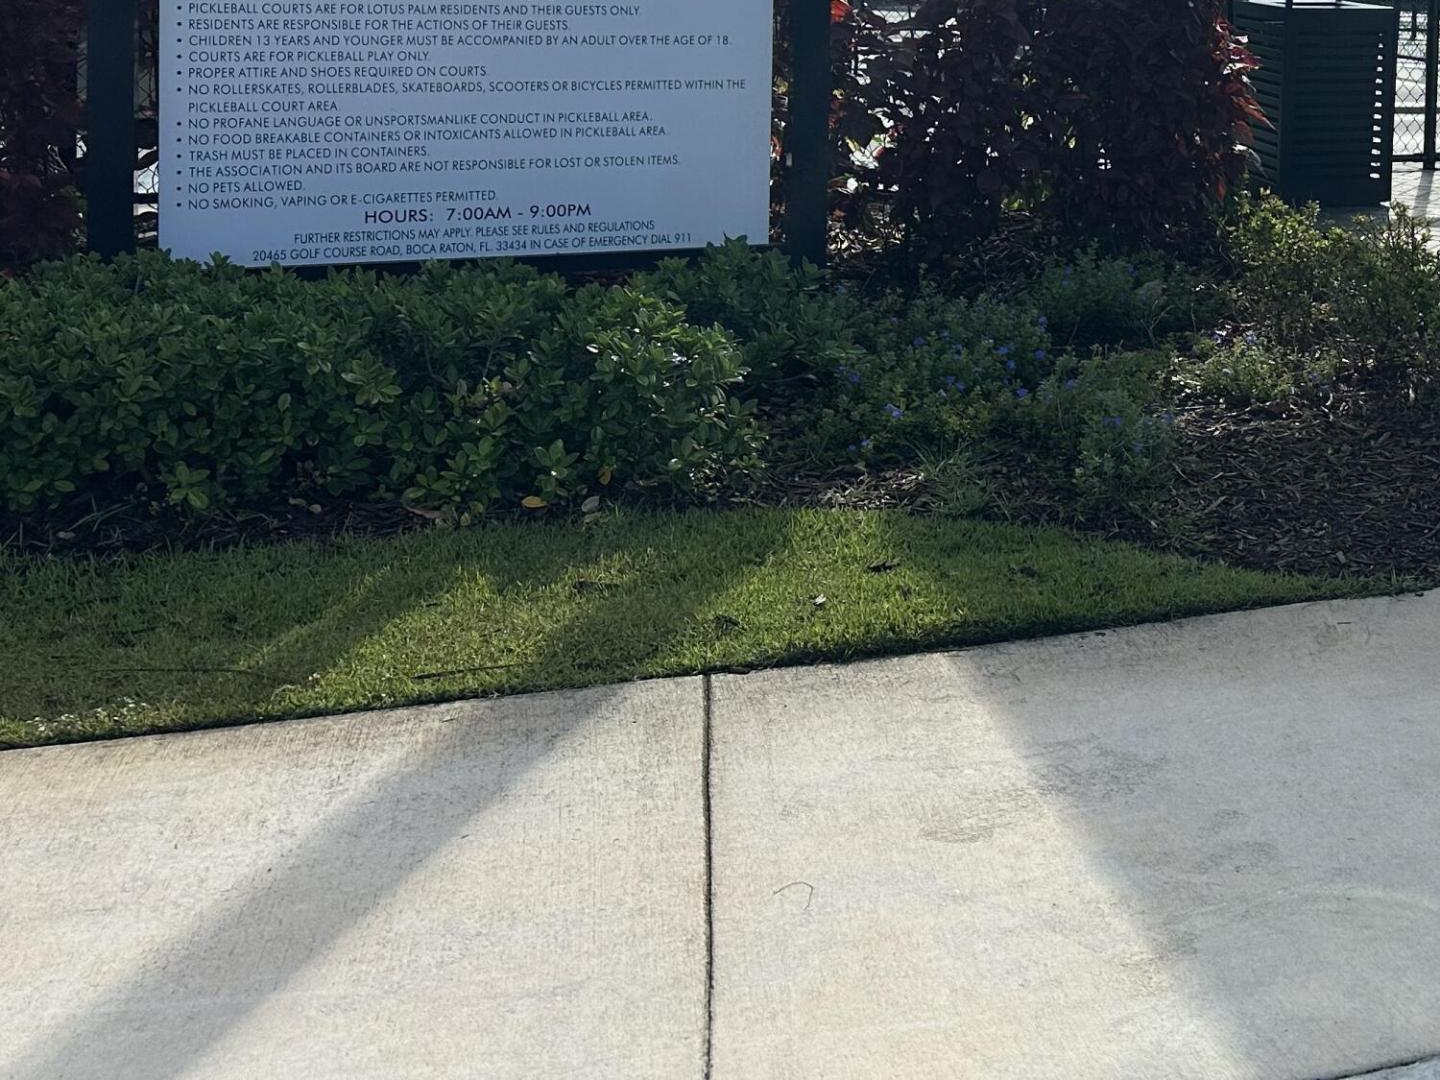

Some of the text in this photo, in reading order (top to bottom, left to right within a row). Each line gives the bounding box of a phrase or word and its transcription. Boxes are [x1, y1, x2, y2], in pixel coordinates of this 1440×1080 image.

[188, 2, 258, 14] PICKLEBALL
[260, 2, 312, 14] COURTS
[314, 3, 336, 14] ARE
[339, 3, 364, 14] FOR
[366, 3, 405, 15] LOTUS
[407, 3, 437, 14] PALM
[439, 3, 501, 15] RESIDENTS
[502, 4, 528, 15] AND
[530, 4, 562, 15] THEIR
[563, 4, 607, 16] GUESTS
[187, 50, 240, 62] COURTS
[242, 50, 266, 62] ARE
[268, 50, 294, 62] FOR
[296, 50, 364, 61] PICKLEBALL
[366, 50, 394, 61] PLAY
[187, 66, 235, 78] PROPER
[237, 66, 277, 78] ATTIRE
[279, 66, 307, 77] AND
[310, 66, 351, 77] SHOES
[353, 65, 413, 78] REQUIRED
[415, 65, 436, 76] ON
[187, 78, 745, 95] NO ROLLERSKATES, ROLLERBLADES, SKATEBOARDS, SCOOTERS OR BICYCLES PERMITTED WITHIN THE
[187, 101, 259, 113] PICKLEBALL
[260, 100, 305, 112] COURT
[187, 117, 210, 129] NO
[212, 116, 270, 128] PROFANE
[272, 115, 341, 127] LANGUAGE
[343, 115, 362, 126] OR
[364, 113, 477, 126] UNSPORTSMANLIKE
[479, 112, 540, 124] CONDUCT
[542, 112, 555, 122] IN
[557, 111, 619, 122] PICKLEBALL
[187, 133, 210, 145] NO
[212, 132, 252, 144] FOOD
[254, 131, 321, 144] BREAKABLE
[323, 130, 401, 142] CONTAINERS
[402, 129, 421, 141] OR
[423, 128, 501, 140] INTOXICANTS
[501, 127, 557, 139] ALLOWED
[559, 127, 572, 137] IN
[574, 126, 636, 137] PICKLEBALL
[188, 149, 228, 161] TRASH
[230, 148, 265, 160] MUST
[267, 148, 282, 160] BE
[285, 147, 331, 159] PLACED
[334, 147, 348, 158] IN
[187, 182, 209, 193] NO
[212, 181, 241, 192] PETS
[187, 198, 209, 210] NO
[212, 196, 277, 209] SMOKING,
[279, 194, 327, 206] VAPING
[329, 194, 348, 205] OR
[350, 191, 433, 205] E-CIGARETTES
[364, 208, 433, 224] HOURS:
[445, 206, 512, 220] 7:00AM
[529, 203, 591, 218] 9:00PM
[293, 231, 340, 244] FURTHER
[342, 228, 416, 242] RESTRICTIONS
[417, 227, 440, 239] MAY
[474, 225, 509, 237] PLEASE
[511, 224, 528, 235] SEE
[530, 223, 561, 234] RULES
[561, 222, 585, 233] AND
[587, 219, 655, 232] REGULATIONS
[251, 249, 287, 263] 20465
[289, 247, 320, 260] GOLF
[322, 245, 367, 258] COURSE
[369, 244, 403, 256] ROAD,
[405, 243, 437, 255] BOCA
[438, 241, 476, 253] RATON,
[495, 239, 527, 251] 33434
[529, 239, 541, 249] IN
[543, 237, 569, 249] CASE
[570, 236, 586, 248] OF
[588, 234, 648, 247] EMERGENCY
[650, 233, 672, 245] DIAL
[673, 232, 692, 244] 911
